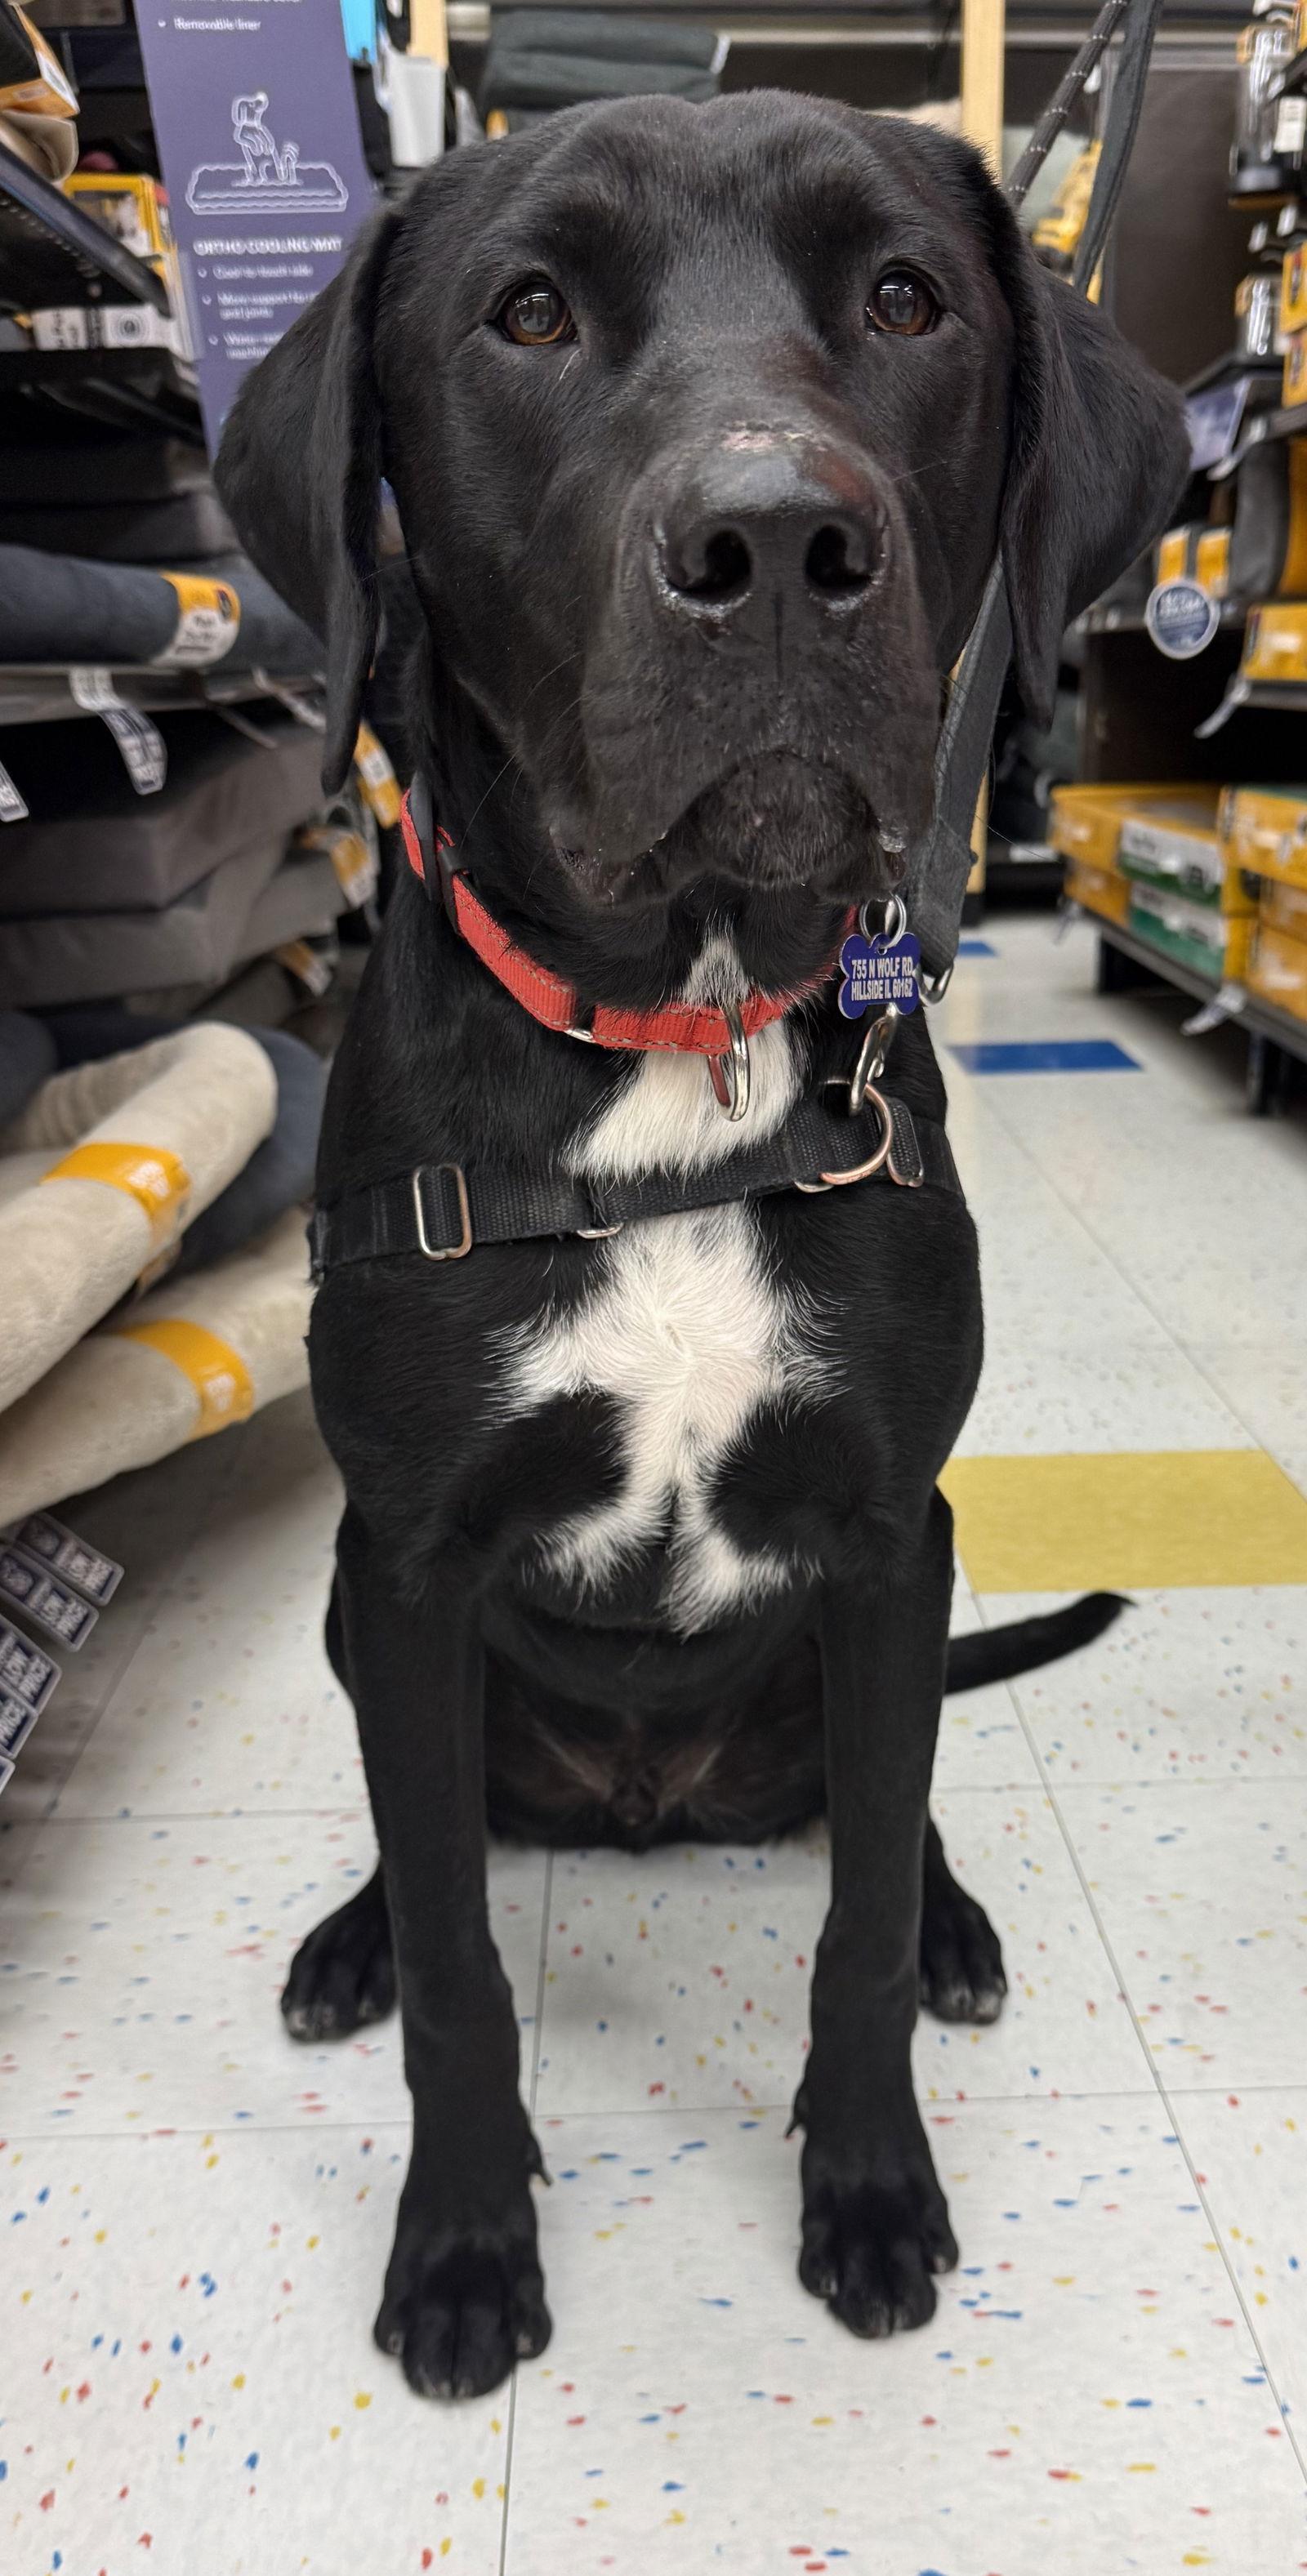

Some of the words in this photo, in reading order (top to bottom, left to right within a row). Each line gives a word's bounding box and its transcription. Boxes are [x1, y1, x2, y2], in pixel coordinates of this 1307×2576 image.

[174, 17, 234, 30] Removable
[194, 238, 246, 256] ORTHO
[246, 237, 310, 254] COOLING
[851, 960, 867, 979] 755
[868, 959, 877, 978] N
[877, 957, 900, 978] WOLF
[902, 956, 913, 977] RD
[851, 980, 884, 1001] HILLSIDE
[885, 978, 891, 1000] IL
[893, 978, 913, 998] 60162
